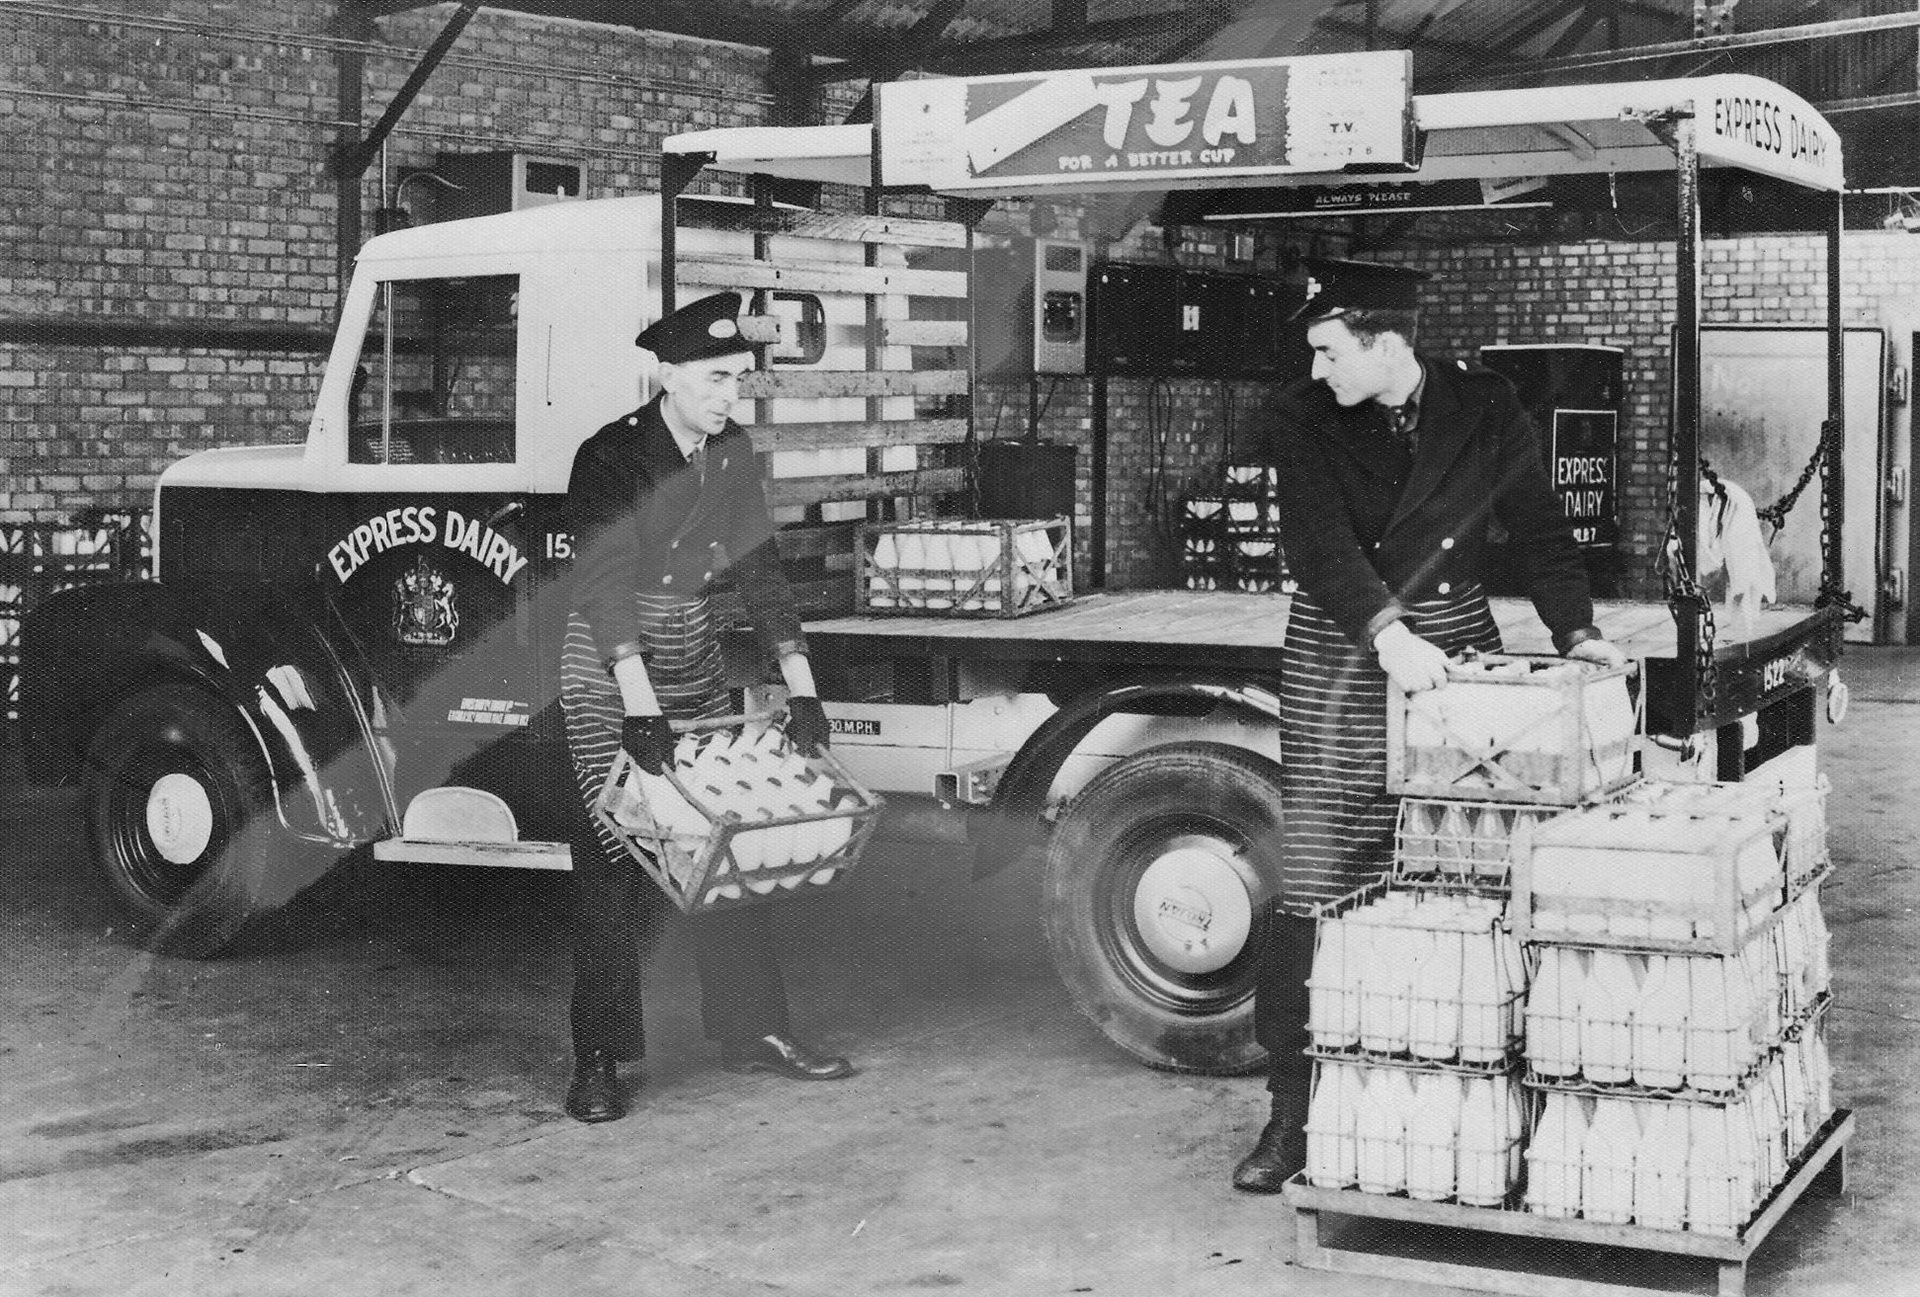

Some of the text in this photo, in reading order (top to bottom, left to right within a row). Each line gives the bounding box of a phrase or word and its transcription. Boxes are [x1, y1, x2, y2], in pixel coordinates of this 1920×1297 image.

[1097, 76, 1256, 150] TEA
[1715, 97, 1828, 168] EXPRESS DAIRY
[1058, 147, 1236, 171] FOR A BETTER CUP
[1315, 192, 1411, 204] ALWAYS PLEASE
[1565, 490, 1604, 517] DAIRY
[328, 506, 529, 586] EXPRESS DAIRY
